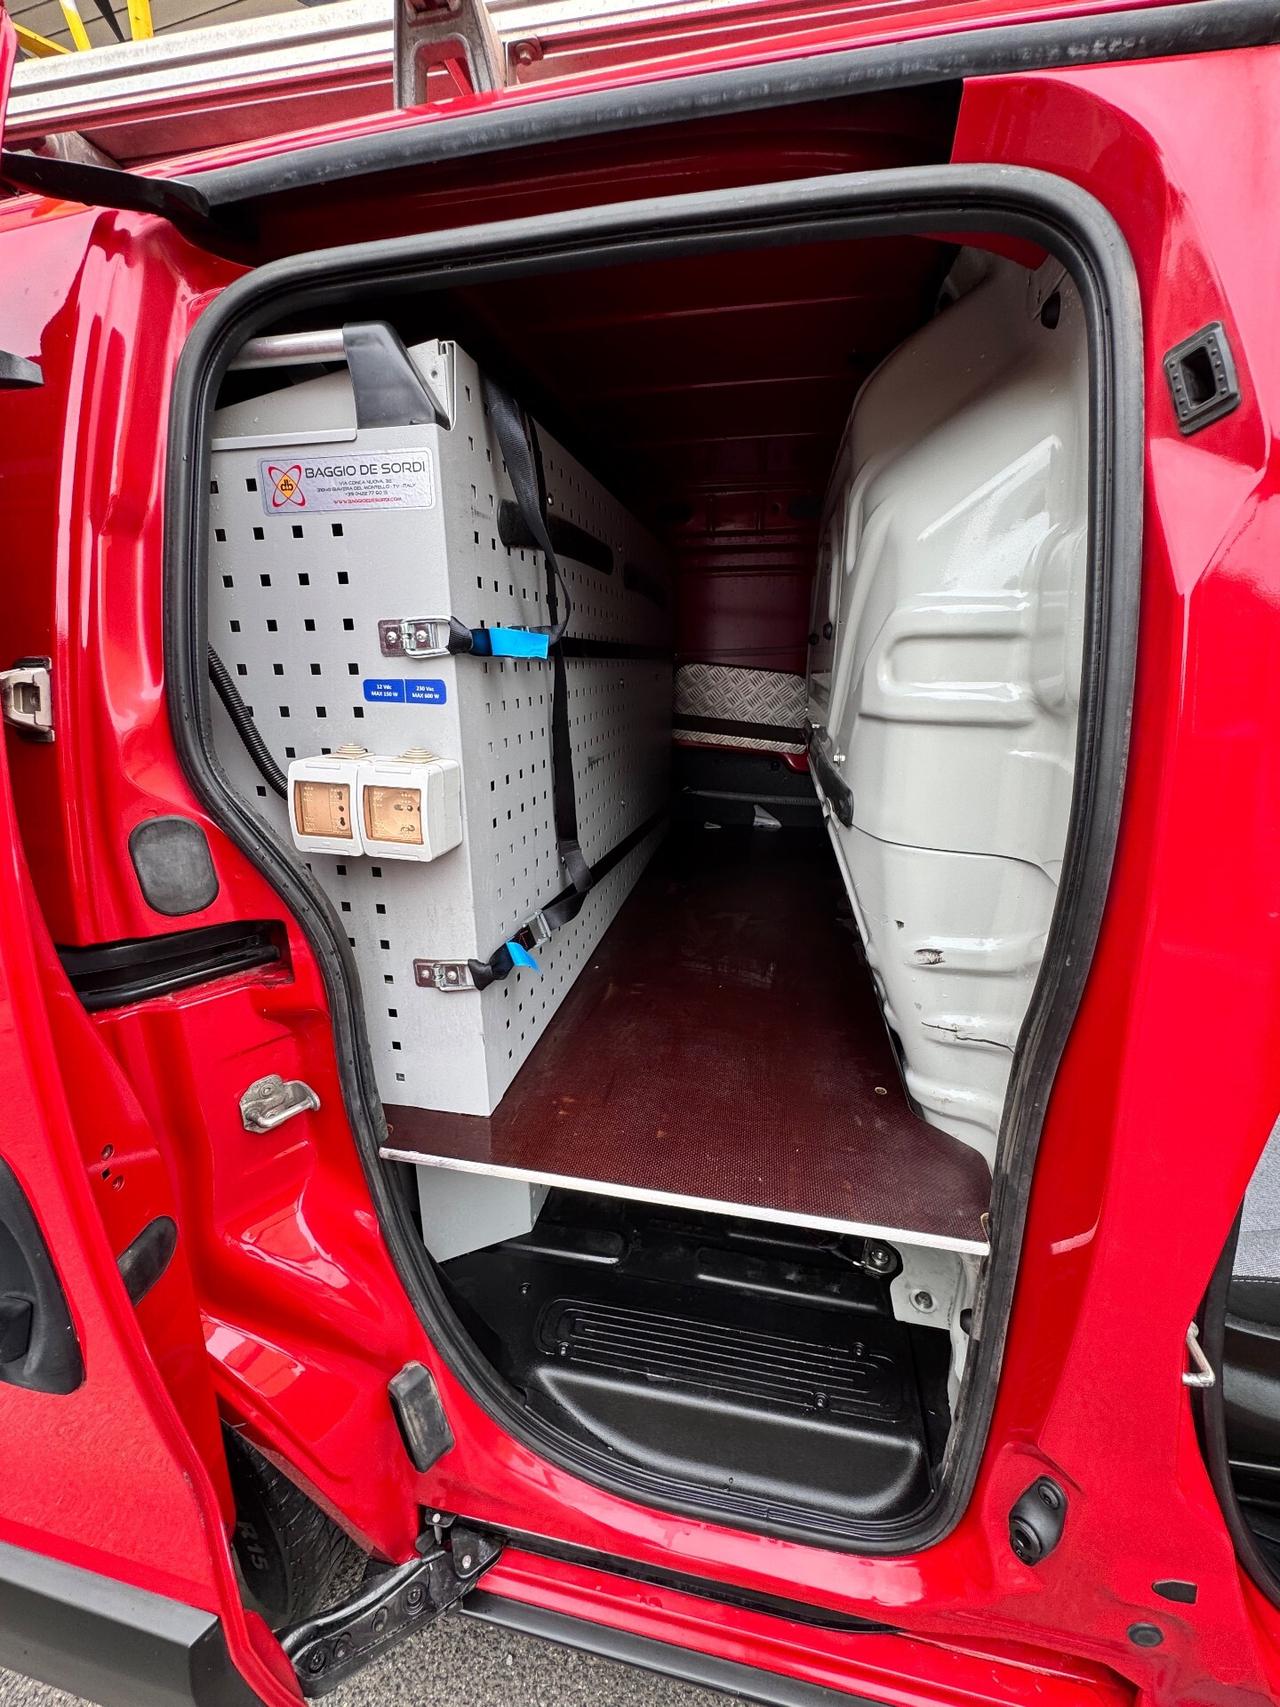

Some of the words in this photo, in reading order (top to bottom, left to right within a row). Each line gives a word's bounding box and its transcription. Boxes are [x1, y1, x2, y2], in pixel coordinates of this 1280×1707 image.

[305, 465, 357, 479] BAGGIO
[359, 464, 378, 476] DE
[381, 461, 425, 474] SORDI
